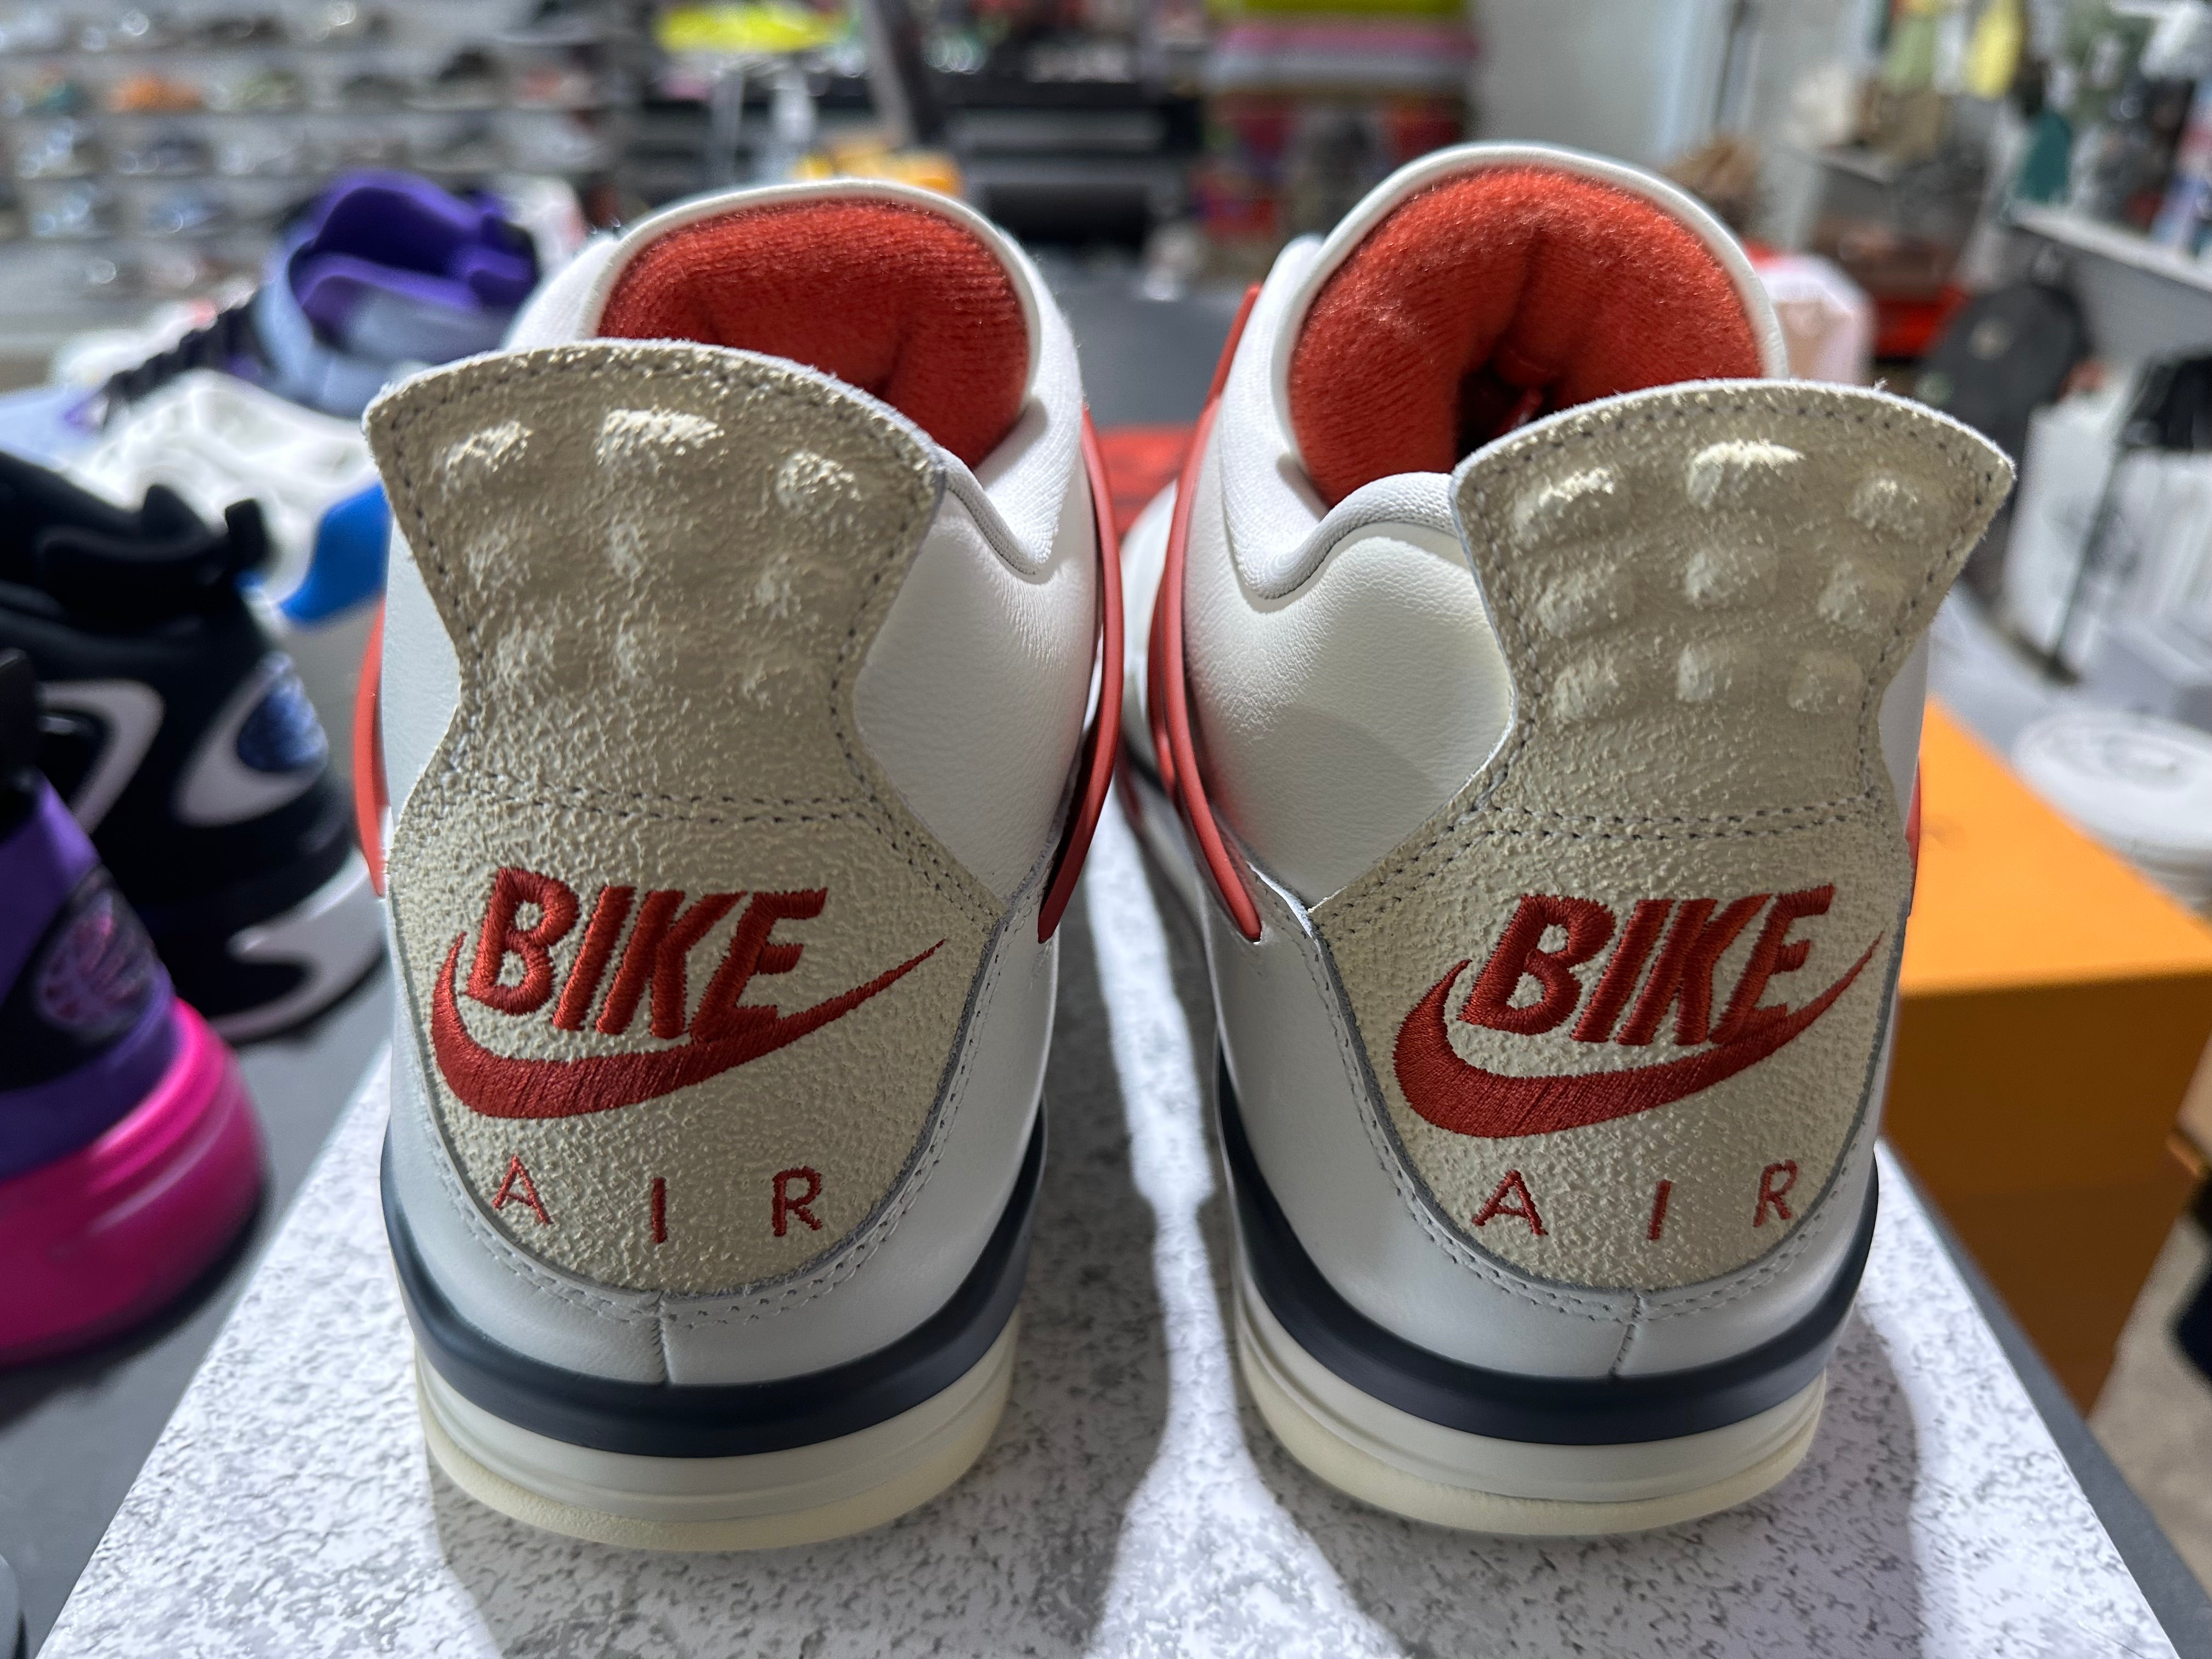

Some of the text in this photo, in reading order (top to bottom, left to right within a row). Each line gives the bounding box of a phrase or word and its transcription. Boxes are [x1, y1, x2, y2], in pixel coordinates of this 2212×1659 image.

[466, 867, 827, 1040] BIKE
[1458, 883, 1835, 1043] BIKE
[493, 1154, 822, 1243] AIR
[1472, 1160, 1798, 1240] AIR
